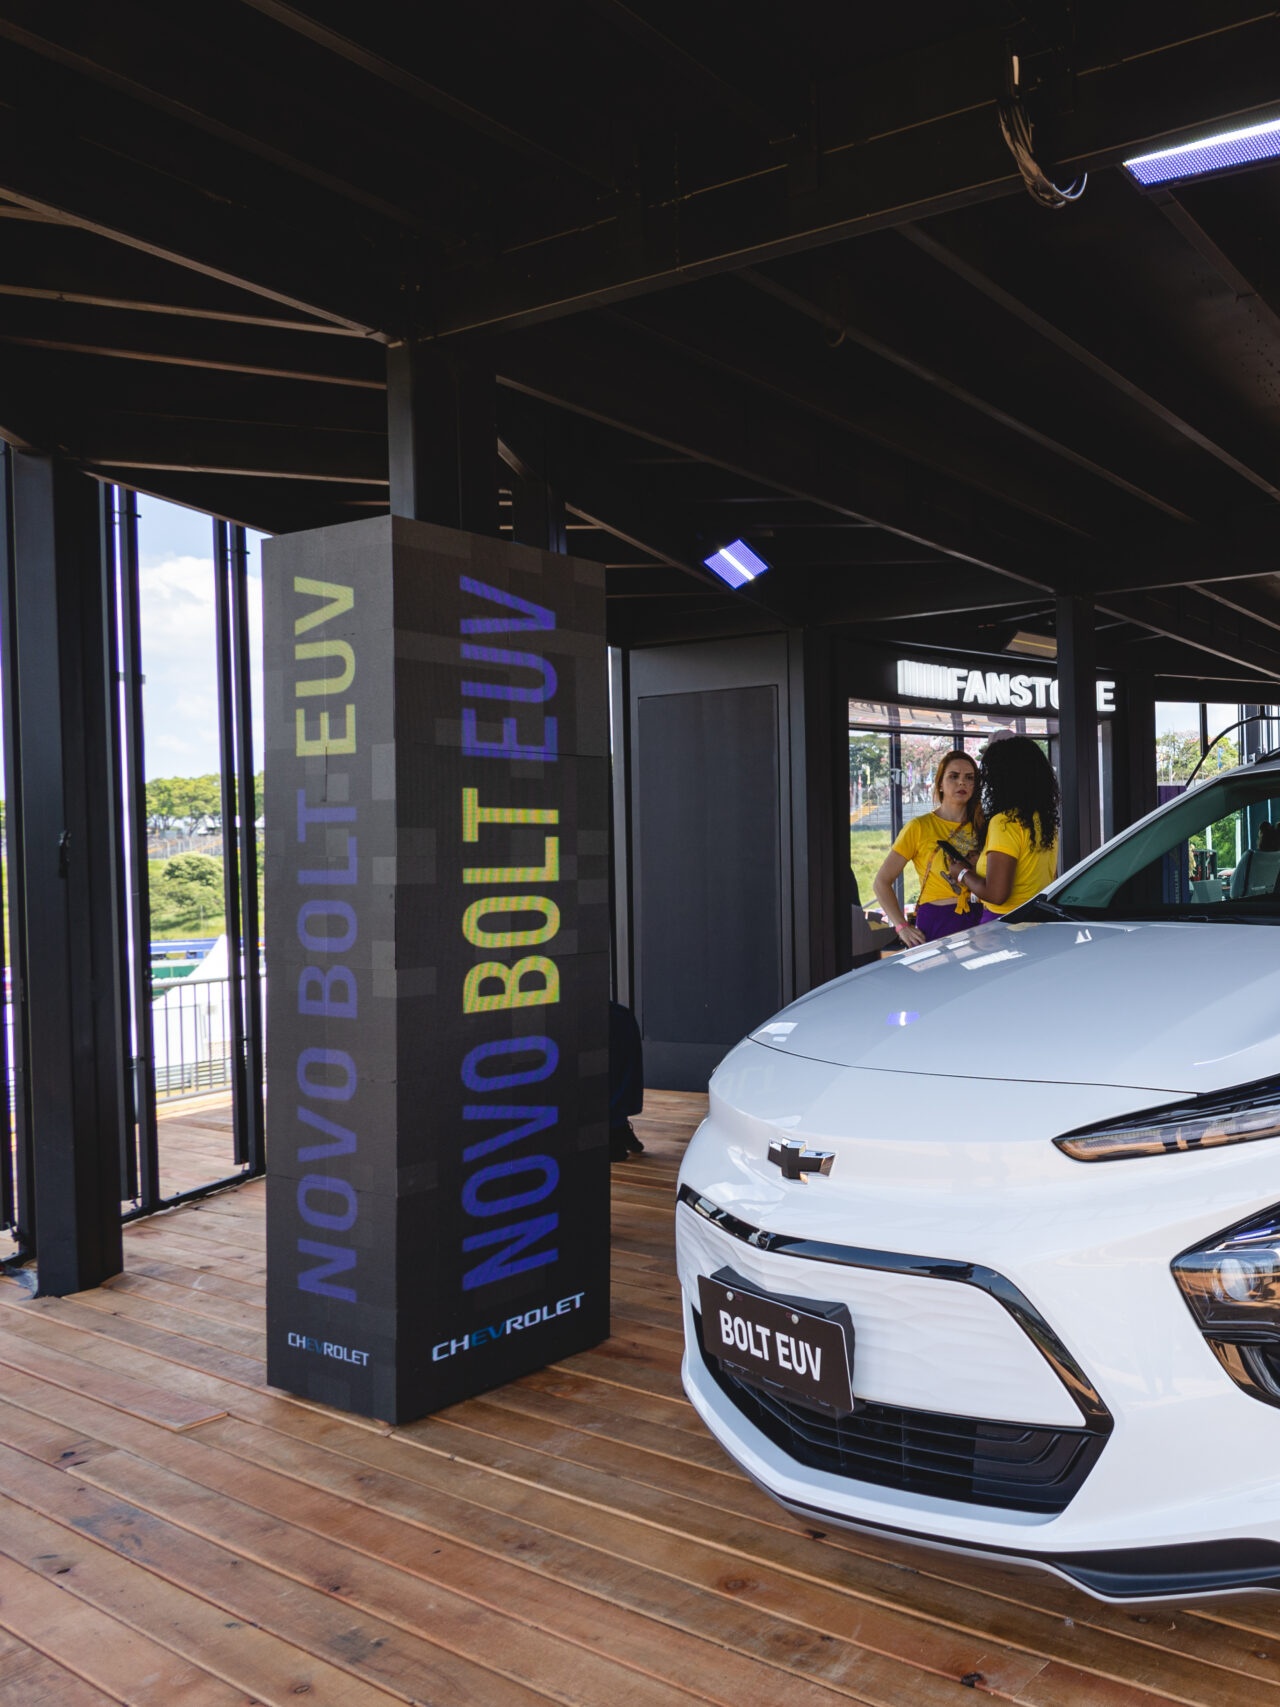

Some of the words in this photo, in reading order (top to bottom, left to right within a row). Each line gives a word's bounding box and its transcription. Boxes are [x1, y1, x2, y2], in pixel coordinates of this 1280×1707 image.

[294, 576, 357, 757] EUV
[460, 575, 558, 762] EUV
[949, 667, 1116, 712] FANSTE
[297, 789, 358, 1020] BOLT
[462, 788, 561, 1014] BOLT
[297, 1046, 358, 1304] NOVO
[461, 1035, 560, 1292] NOVO
[287, 1332, 370, 1367] CHEVROLET
[431, 1292, 585, 1362] CHEVROLET
[719, 1309, 771, 1362] BOLT
[775, 1331, 822, 1382] EUV
